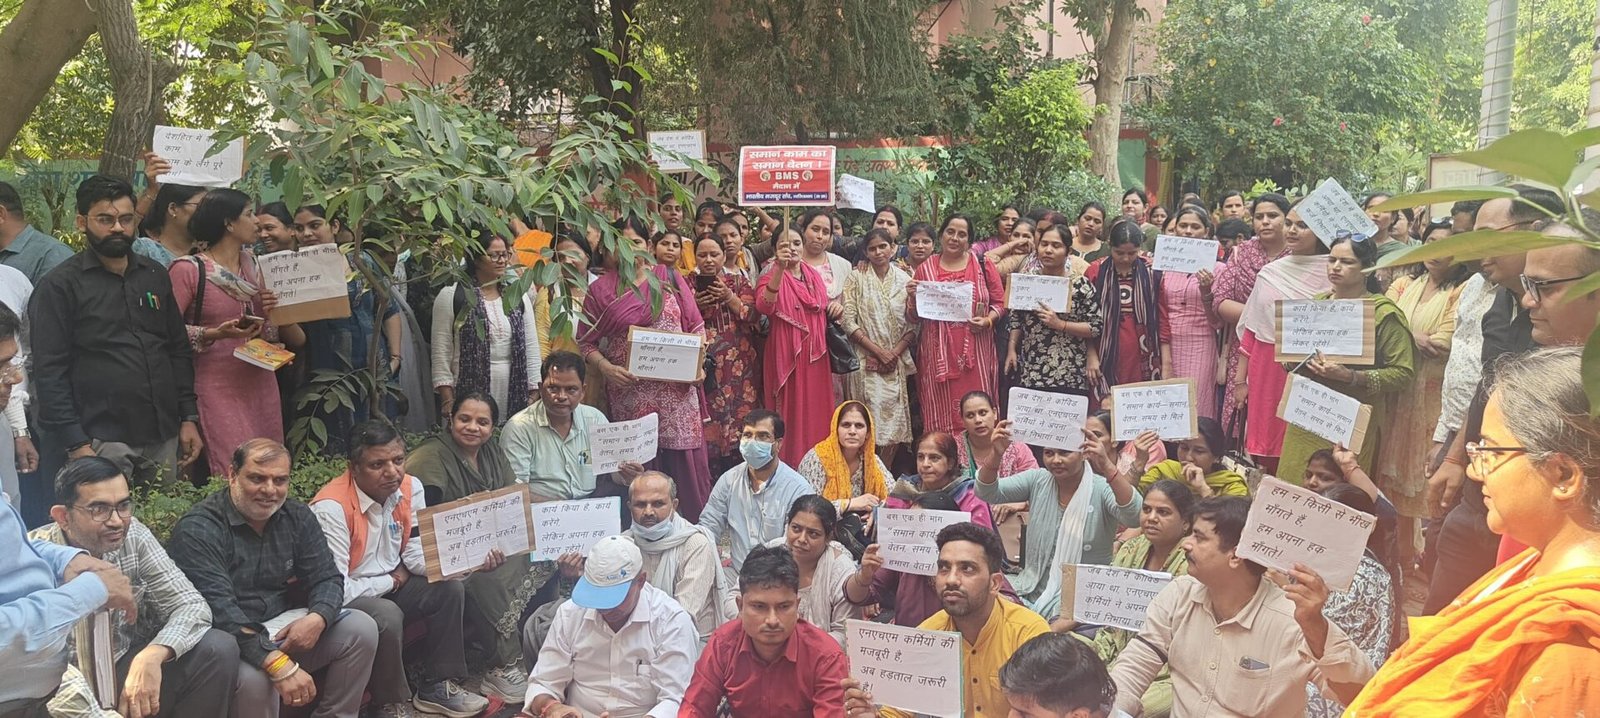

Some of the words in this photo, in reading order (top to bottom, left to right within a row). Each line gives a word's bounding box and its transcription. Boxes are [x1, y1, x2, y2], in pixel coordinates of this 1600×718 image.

[213, 161, 223, 170] पूरे
[787, 160, 813, 169] वेतन
[776, 172, 799, 180] BMS
[287, 277, 305, 285] अपना
[1293, 304, 1307, 312] कार्य
[1292, 327, 1313, 335] लेकिन
[1056, 398, 1078, 406] कोविड
[1016, 405, 1031, 413] आया
[1311, 416, 1324, 425] समय
[1029, 430, 1052, 440] निभाया
[445, 508, 478, 524] एनएचएम
[511, 496, 520, 505] की
[561, 504, 580, 512] किया
[595, 502, 611, 510] कार्य
[1265, 503, 1293, 520] माँगते
[1272, 485, 1288, 497] हम
[1292, 493, 1301, 503] न
[1303, 496, 1331, 514] किसी
[1335, 509, 1346, 519] से
[1349, 515, 1371, 529] भीख
[919, 513, 926, 523] ही
[446, 522, 472, 536] मजबूरी
[448, 542, 461, 551] अब
[496, 525, 517, 537] जरूरी
[542, 532, 564, 542] लेकिन
[568, 531, 588, 539] अपना
[1257, 523, 1273, 534] हम
[1276, 532, 1304, 546] अपना
[1307, 542, 1327, 554] हक
[542, 546, 561, 555] लेकर
[1106, 569, 1119, 577] देश
[1126, 587, 1158, 599] एनएचए
[1125, 604, 1147, 613] अपना
[1104, 612, 1130, 626] निभाया
[859, 628, 899, 642] एनएचएम
[904, 634, 935, 647] कर्मियों
[941, 637, 955, 649] की
[861, 646, 890, 661] मजबूरी
[895, 650, 903, 663] है,
[861, 666, 875, 675] अब
[880, 669, 912, 683] हड़ताल
[918, 675, 946, 688] जरूरी
